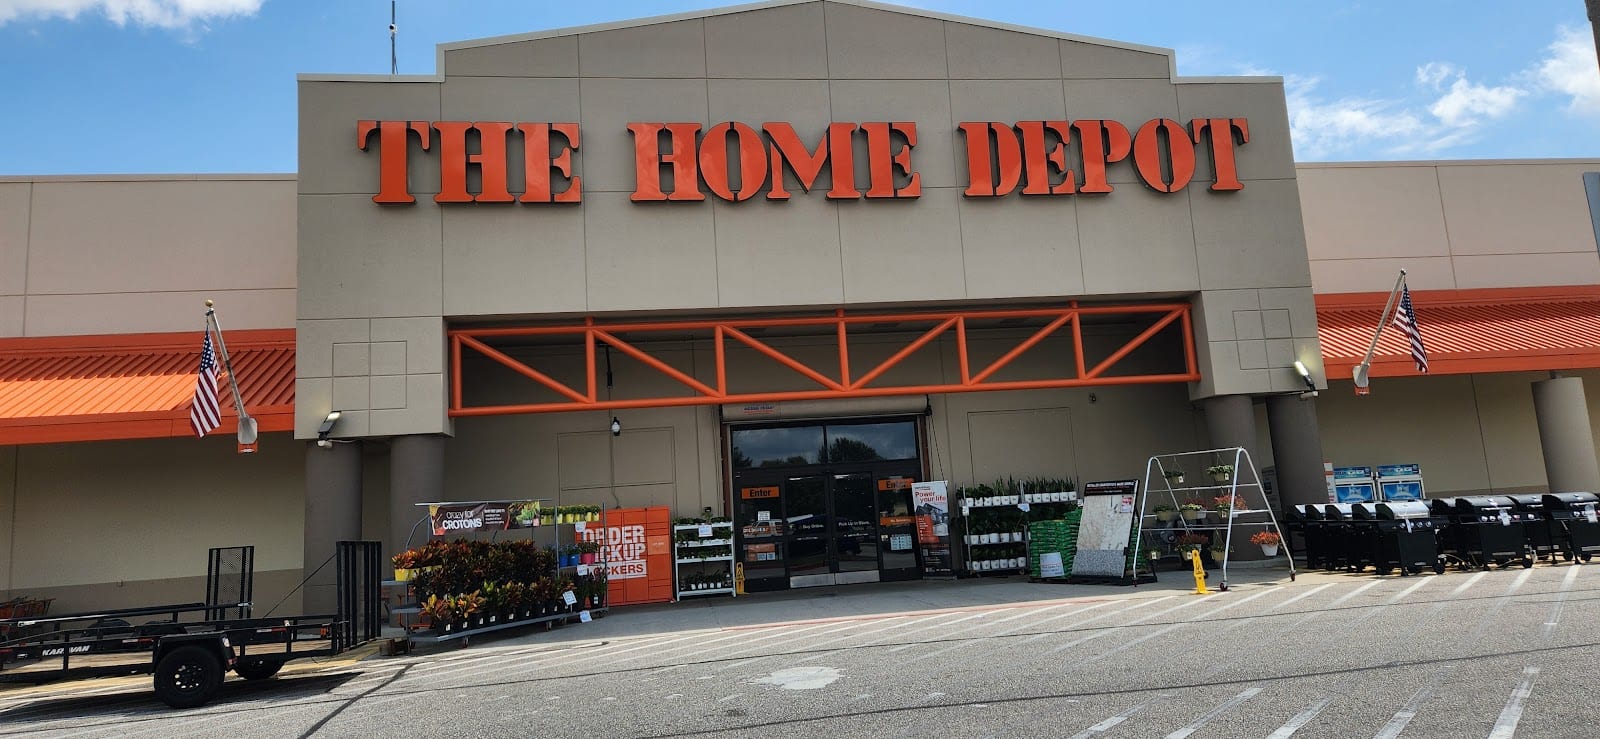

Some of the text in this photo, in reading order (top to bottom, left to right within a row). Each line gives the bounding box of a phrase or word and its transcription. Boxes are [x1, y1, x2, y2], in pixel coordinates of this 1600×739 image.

[357, 118, 1249, 204] THE HOME DEPOT
[750, 489, 771, 497] Enter
[446, 511, 464, 520] crazy
[442, 518, 483, 530] CROTONS
[595, 543, 646, 563] ICKUP
[42, 645, 90, 656] KARVAN
